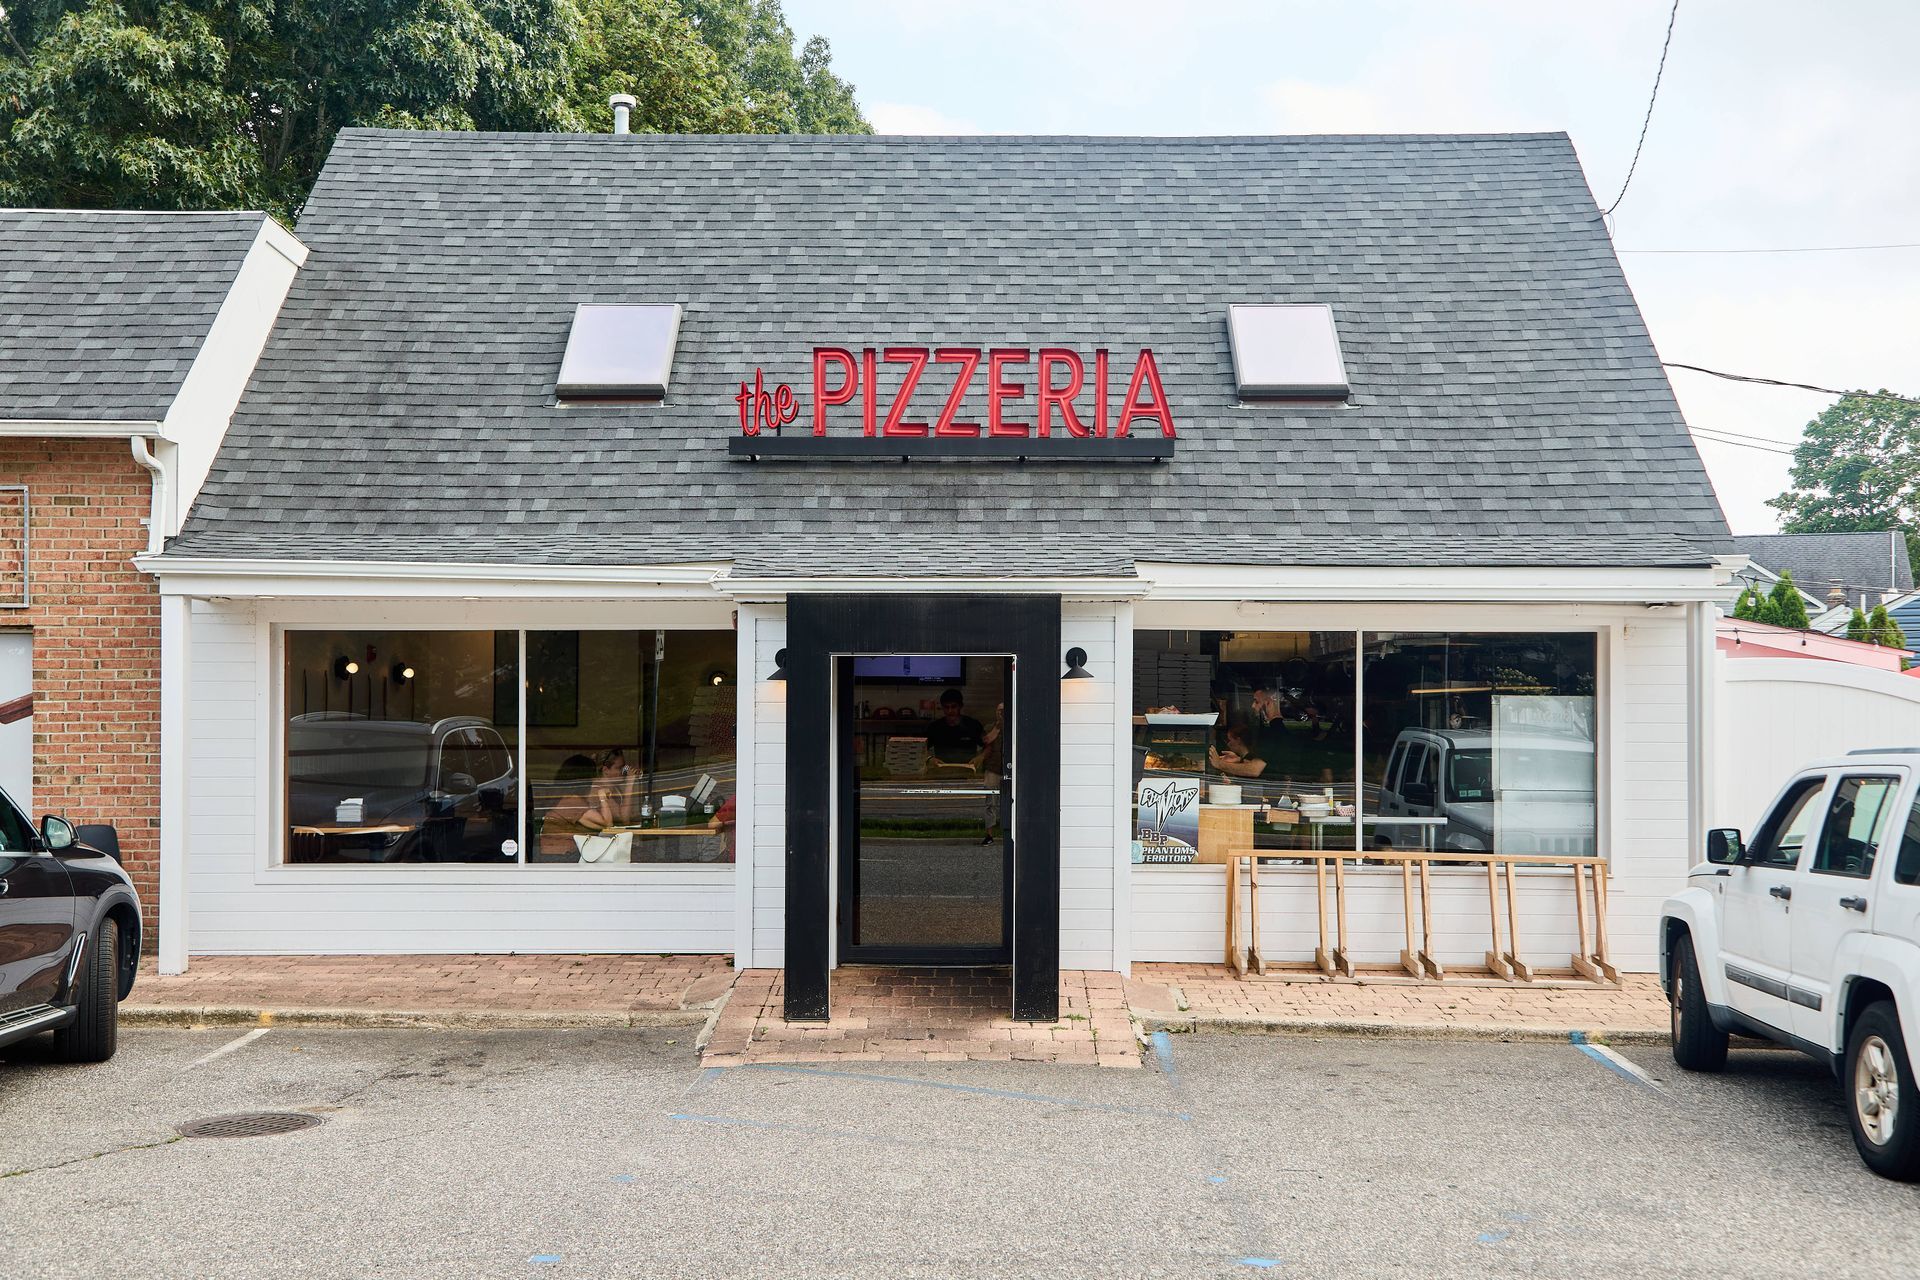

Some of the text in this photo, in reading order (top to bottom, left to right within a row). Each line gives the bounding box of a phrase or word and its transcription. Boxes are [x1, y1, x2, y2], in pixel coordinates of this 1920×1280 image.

[735, 346, 1177, 438] the PIZZERIA
[1141, 829, 1168, 846] BBP
[1142, 846, 1195, 854] PHANTOMS
